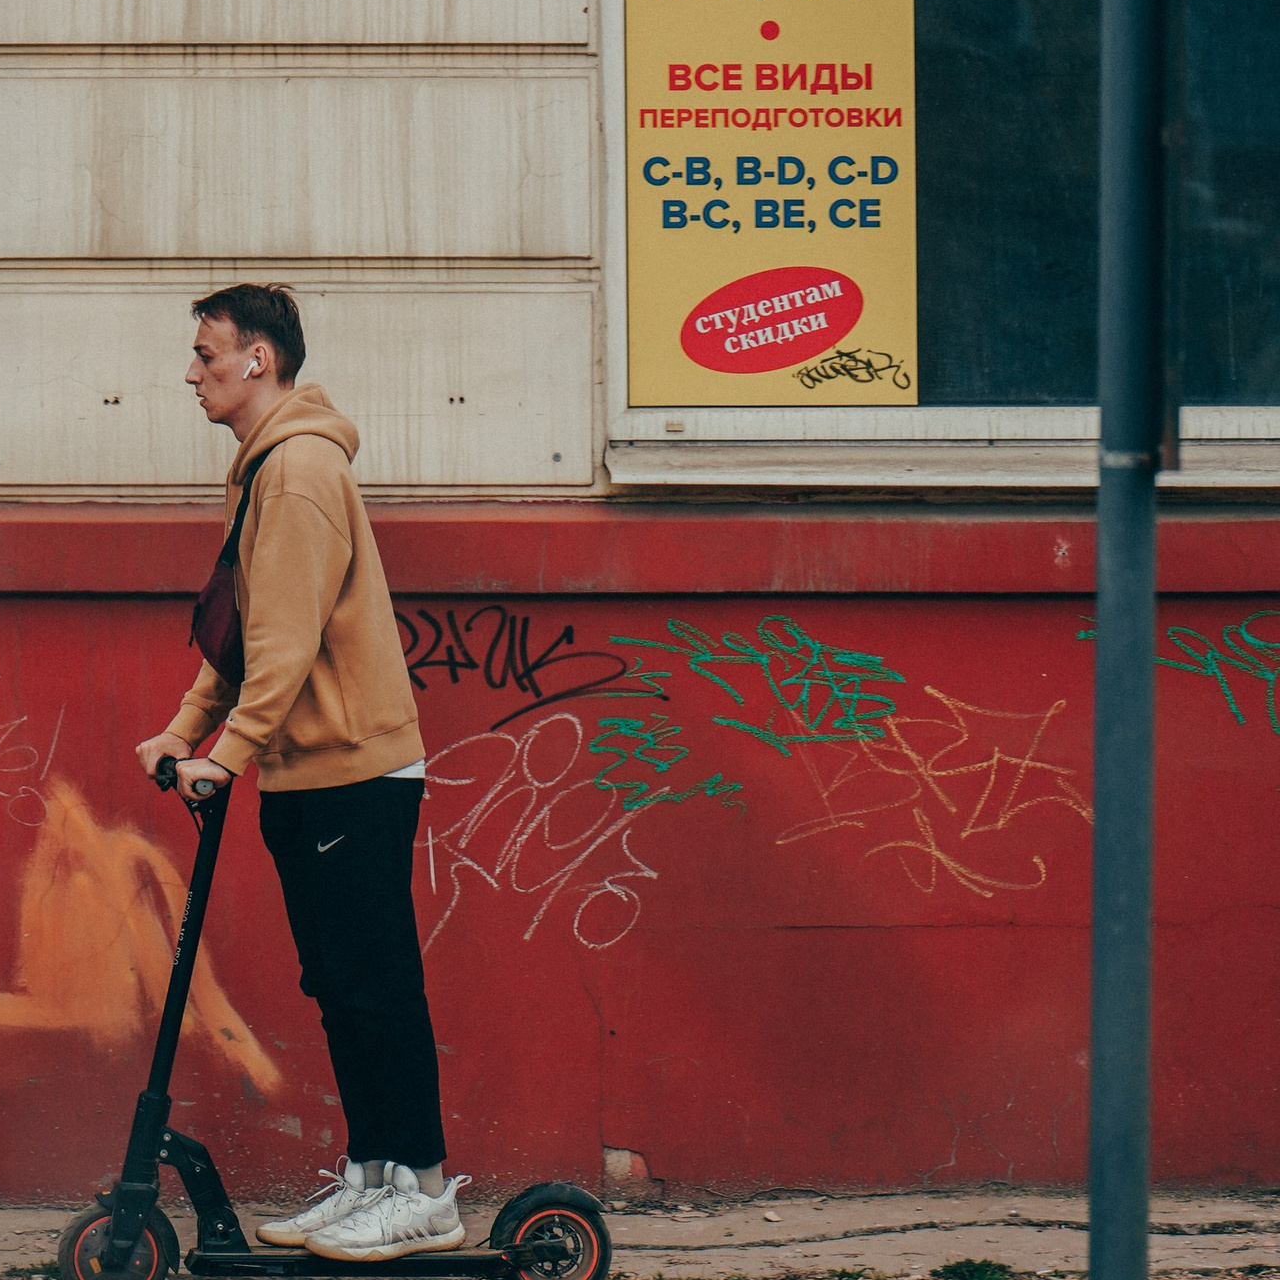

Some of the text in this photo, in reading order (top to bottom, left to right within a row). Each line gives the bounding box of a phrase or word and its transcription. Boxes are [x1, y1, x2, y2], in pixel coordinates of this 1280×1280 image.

[668, 64, 873, 95] ВСЕ ВИДЫ
[639, 108, 903, 131] ПЕРЕПОДГОТОВКИ
[643, 155, 899, 190] C-B, B-D, C-D
[662, 199, 881, 234] B-C, BE, CE
[694, 279, 844, 334] студентам
[723, 311, 830, 354] скидки
